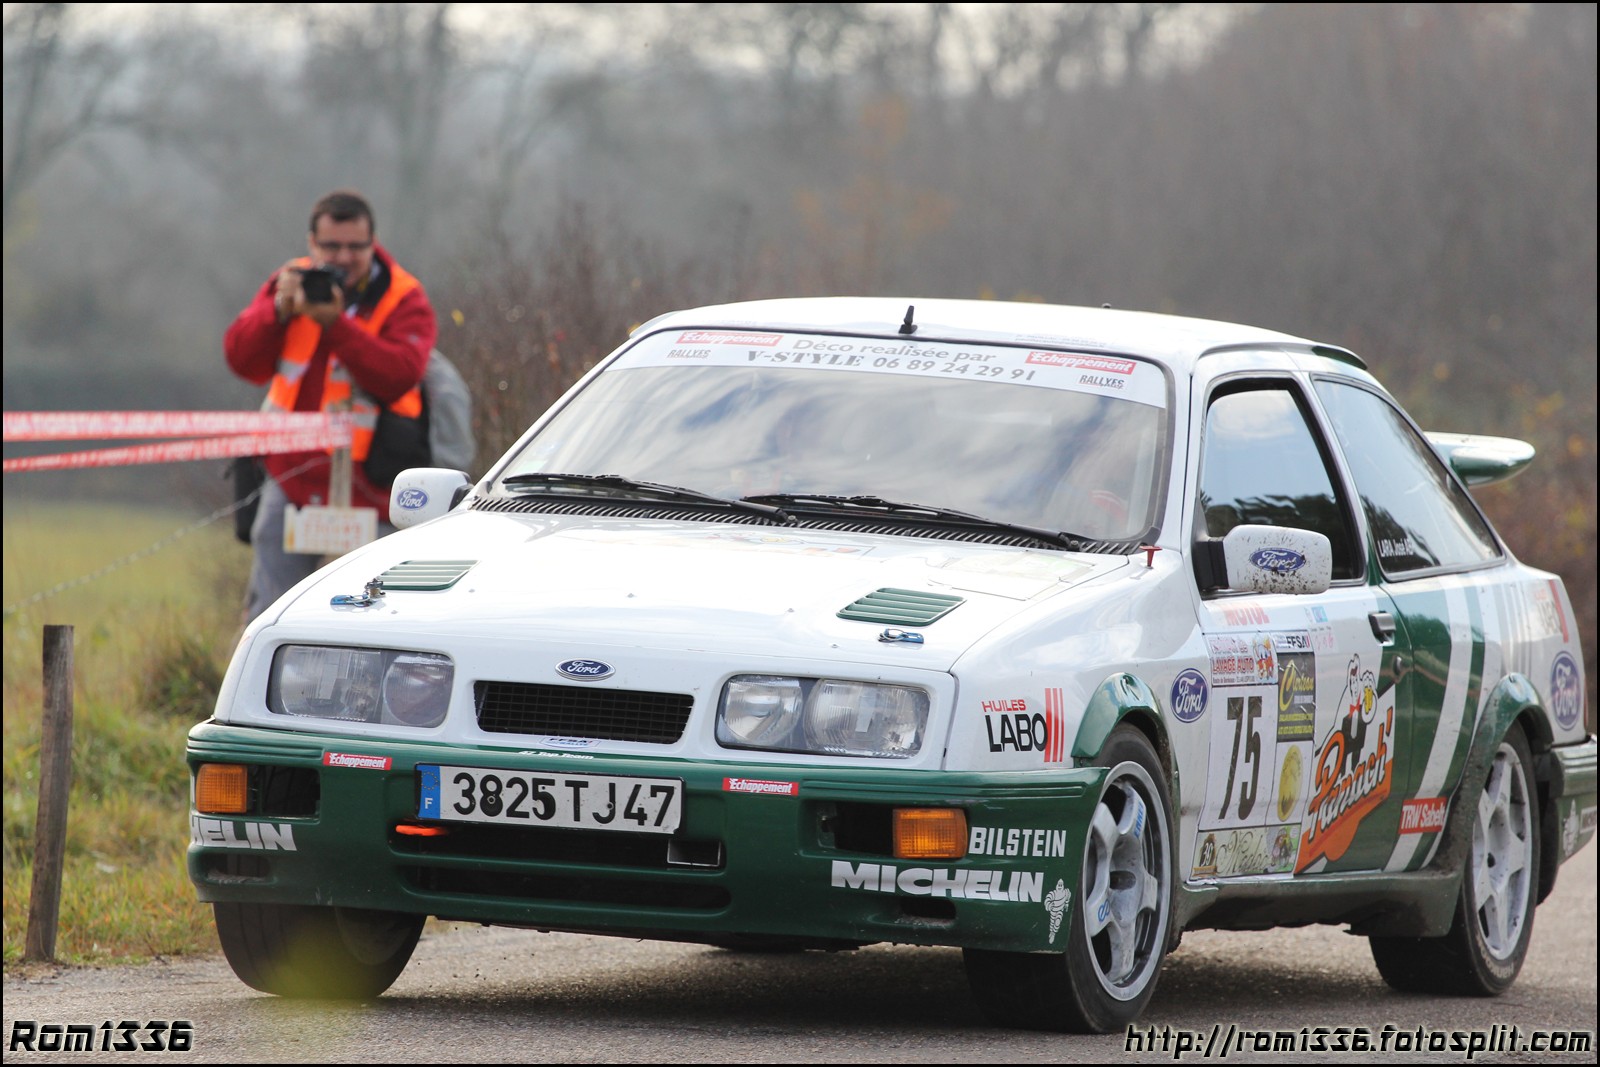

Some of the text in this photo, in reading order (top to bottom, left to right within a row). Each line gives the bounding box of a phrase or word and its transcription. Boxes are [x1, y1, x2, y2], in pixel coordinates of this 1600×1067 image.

[792, 338, 998, 363] Déco realisée par
[748, 350, 1036, 382] V-STYLE 06 89 24 29 91
[399, 491, 425, 509] Ford
[1256, 550, 1297, 569] Ford
[566, 660, 601, 674] Ford
[1175, 676, 1205, 715] Ford
[1558, 663, 1578, 717] Ford
[982, 699, 1026, 712] HUILES
[985, 712, 1048, 752] LABO
[329, 752, 387, 769] Echappement
[561, 752, 595, 760] Team
[1218, 695, 1263, 820] 75
[729, 778, 793, 794] Echappement
[424, 797, 433, 809] F
[1401, 803, 1445, 829] TRW Sabelt
[968, 826, 1067, 857] BILSTEIN
[831, 860, 1044, 903] MICHELIN
